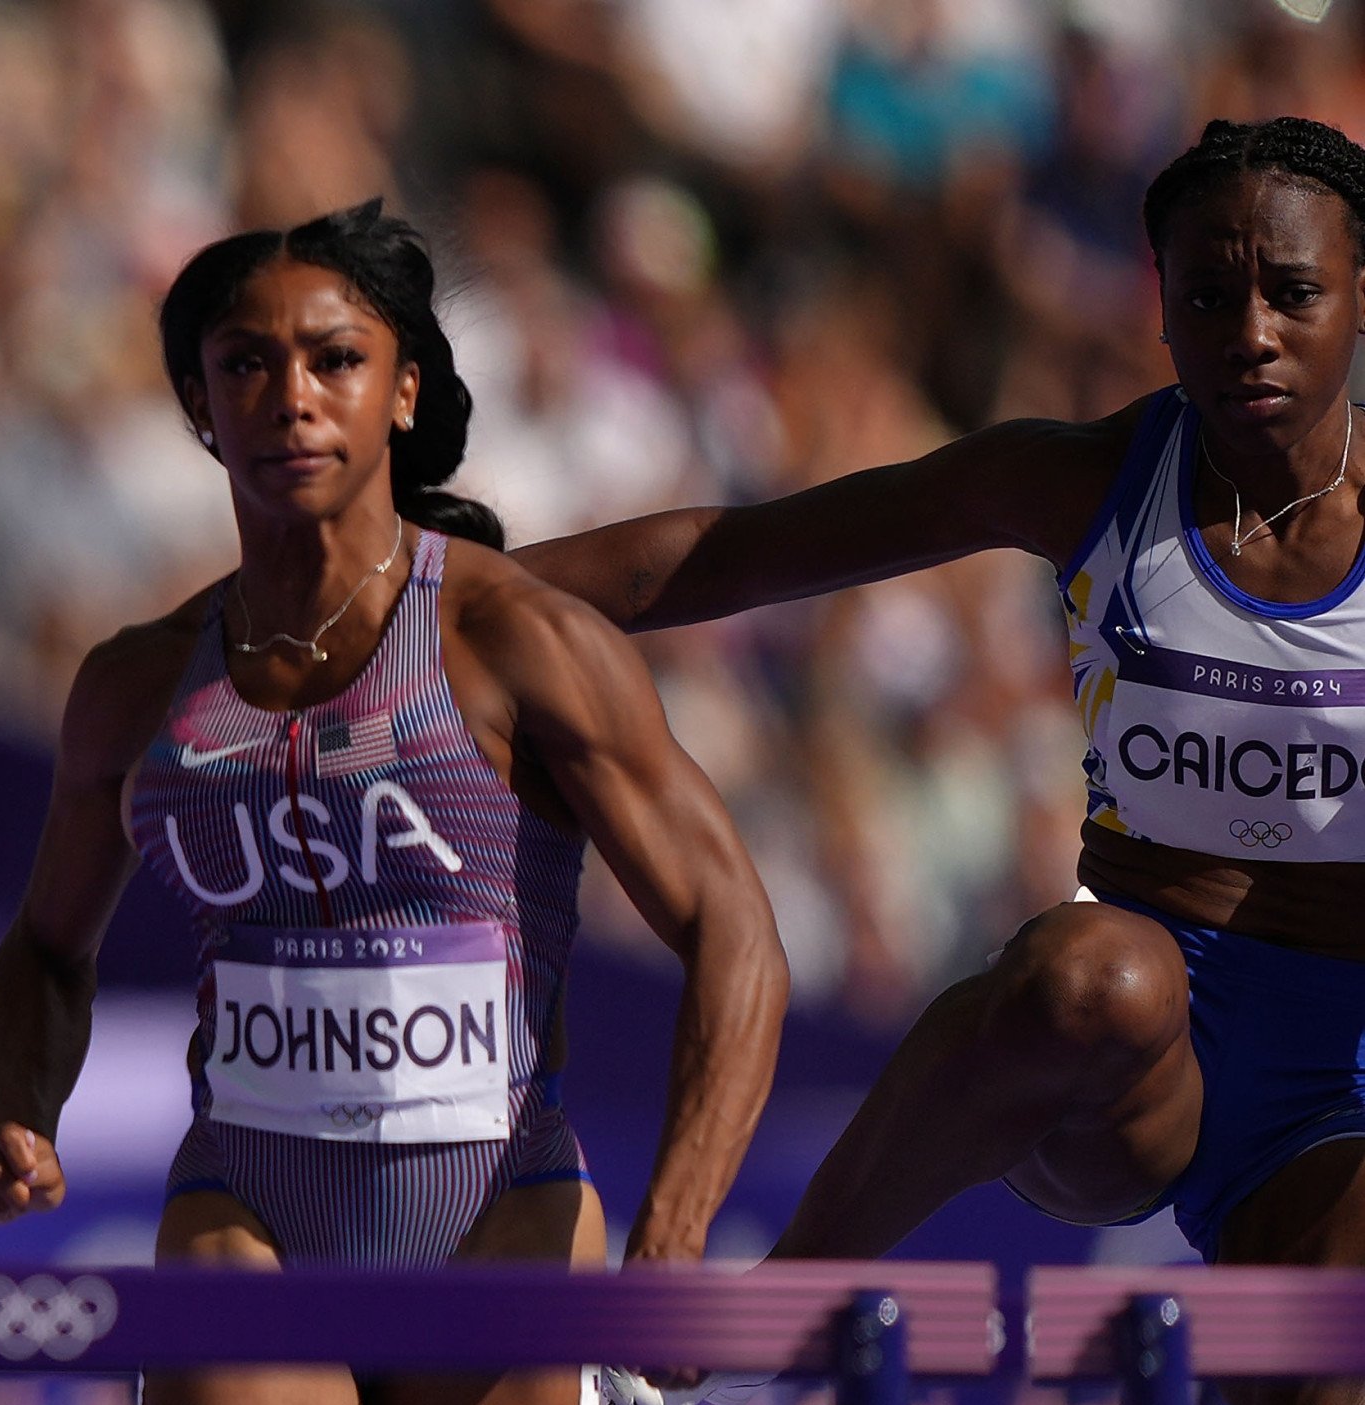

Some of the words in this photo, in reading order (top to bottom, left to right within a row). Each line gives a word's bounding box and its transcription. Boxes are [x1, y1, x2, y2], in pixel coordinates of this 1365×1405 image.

[1273, 679, 1340, 696] 2024
[1118, 723, 1365, 801] CAICED
[166, 779, 463, 906] USA
[354, 936, 423, 959] 2024
[222, 1000, 498, 1072] JOHNSON
